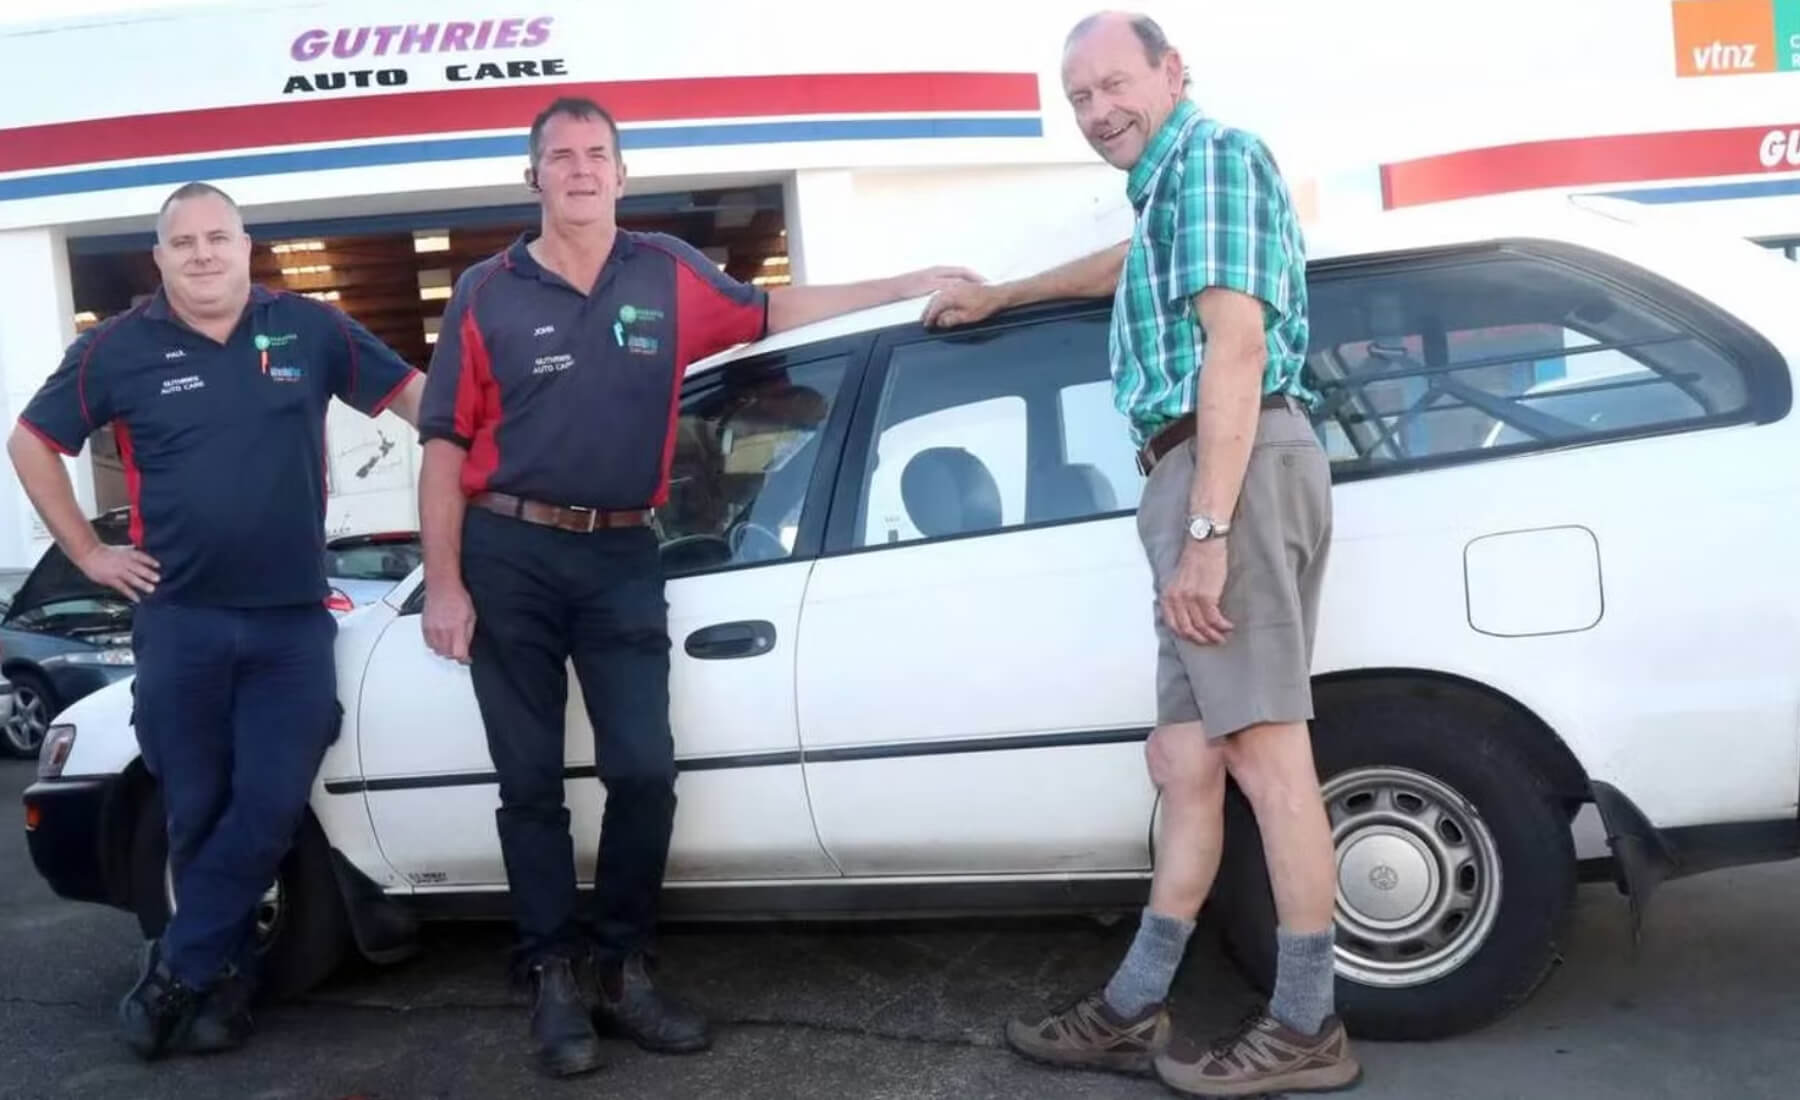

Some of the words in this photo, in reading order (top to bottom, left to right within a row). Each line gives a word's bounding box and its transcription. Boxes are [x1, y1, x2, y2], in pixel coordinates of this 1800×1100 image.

[290, 16, 554, 62] GUTHRIES
[1692, 40, 1757, 72] vtnz
[283, 68, 408, 94] AUTO
[445, 58, 568, 82] CARE
